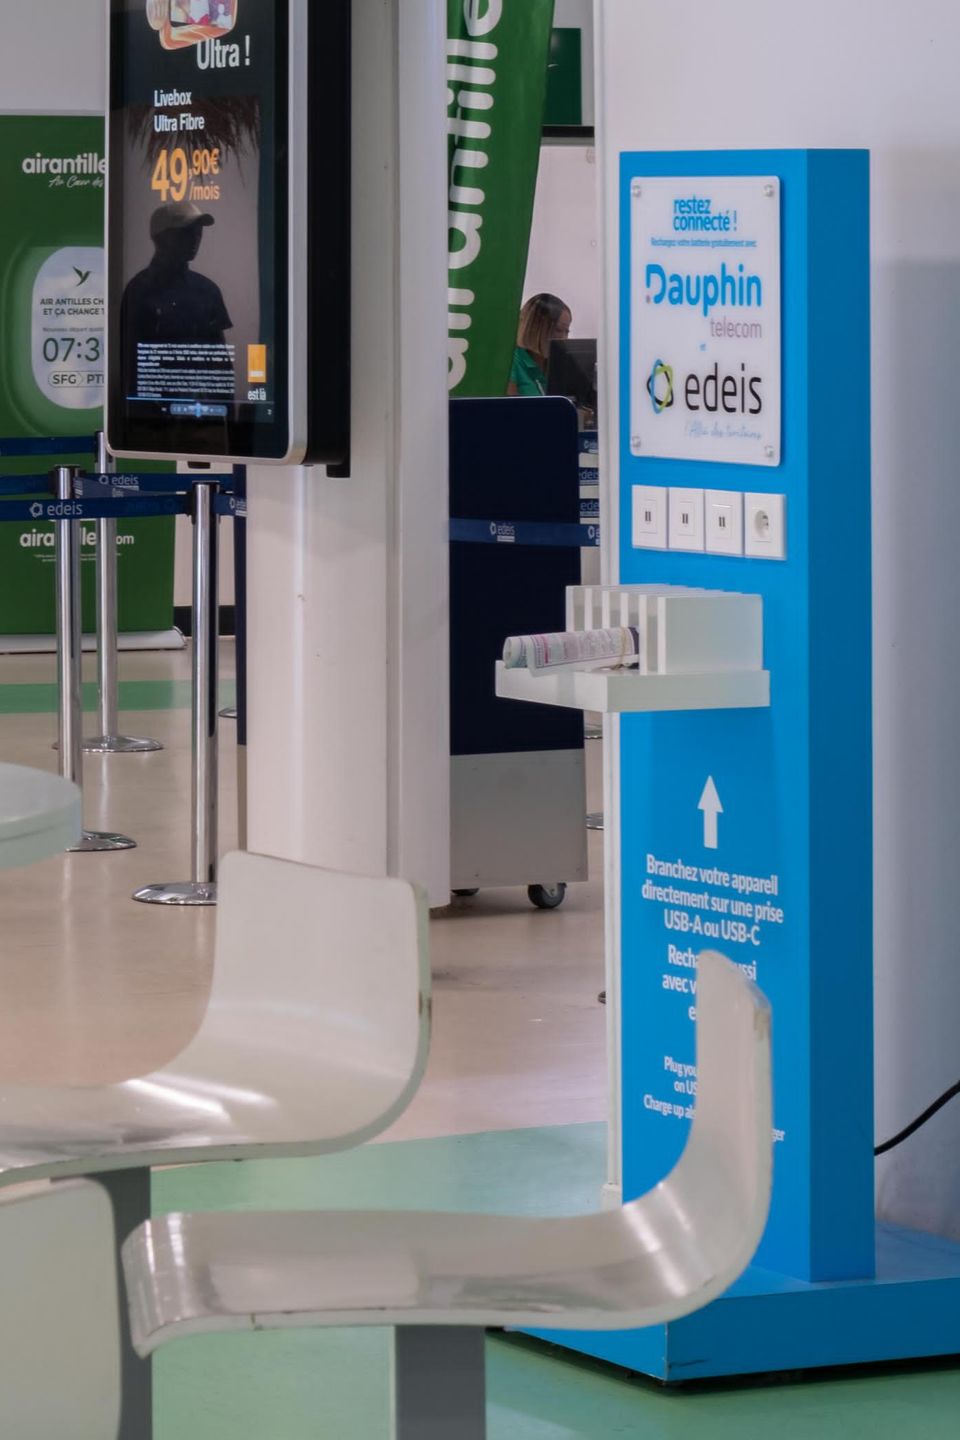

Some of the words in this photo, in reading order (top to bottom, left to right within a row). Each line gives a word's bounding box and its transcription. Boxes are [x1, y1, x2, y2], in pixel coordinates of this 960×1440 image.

[197, 38, 239, 70] Ultra
[154, 89, 192, 107] Livebox
[154, 114, 178, 133] Ultra
[180, 113, 205, 131] Fibre
[22, 152, 105, 175] airantille
[189, 181, 220, 201] /mois
[673, 194, 711, 214] restez
[673, 210, 730, 232] connecté
[645, 262, 762, 317] Dauphin
[55, 298, 92, 306] ANTILLES
[54, 308, 66, 318] ÇA
[67, 308, 100, 316] CHANGE
[710, 316, 762, 339] telecom
[43, 337, 103, 362] 07:3
[52, 374, 77, 385] SFG
[684, 362, 762, 415] edeis
[112, 474, 139, 485] edeis
[47, 502, 83, 516] edeis
[646, 854, 698, 882] Branchez
[700, 867, 730, 887] votre
[732, 874, 778, 896] appareil
[642, 879, 709, 910] directement
[711, 897, 729, 914] sur
[731, 900, 753, 917] une
[755, 901, 784, 924] prise
[664, 909, 703, 935] USB-A
[704, 921, 719, 938] ou
[721, 919, 760, 946] USB-C
[662, 973, 688, 993] avec
[664, 1056, 683, 1077] Plug
[674, 1081, 685, 1093] on
[643, 1094, 672, 1116] Charge
[673, 1104, 684, 1119] up
